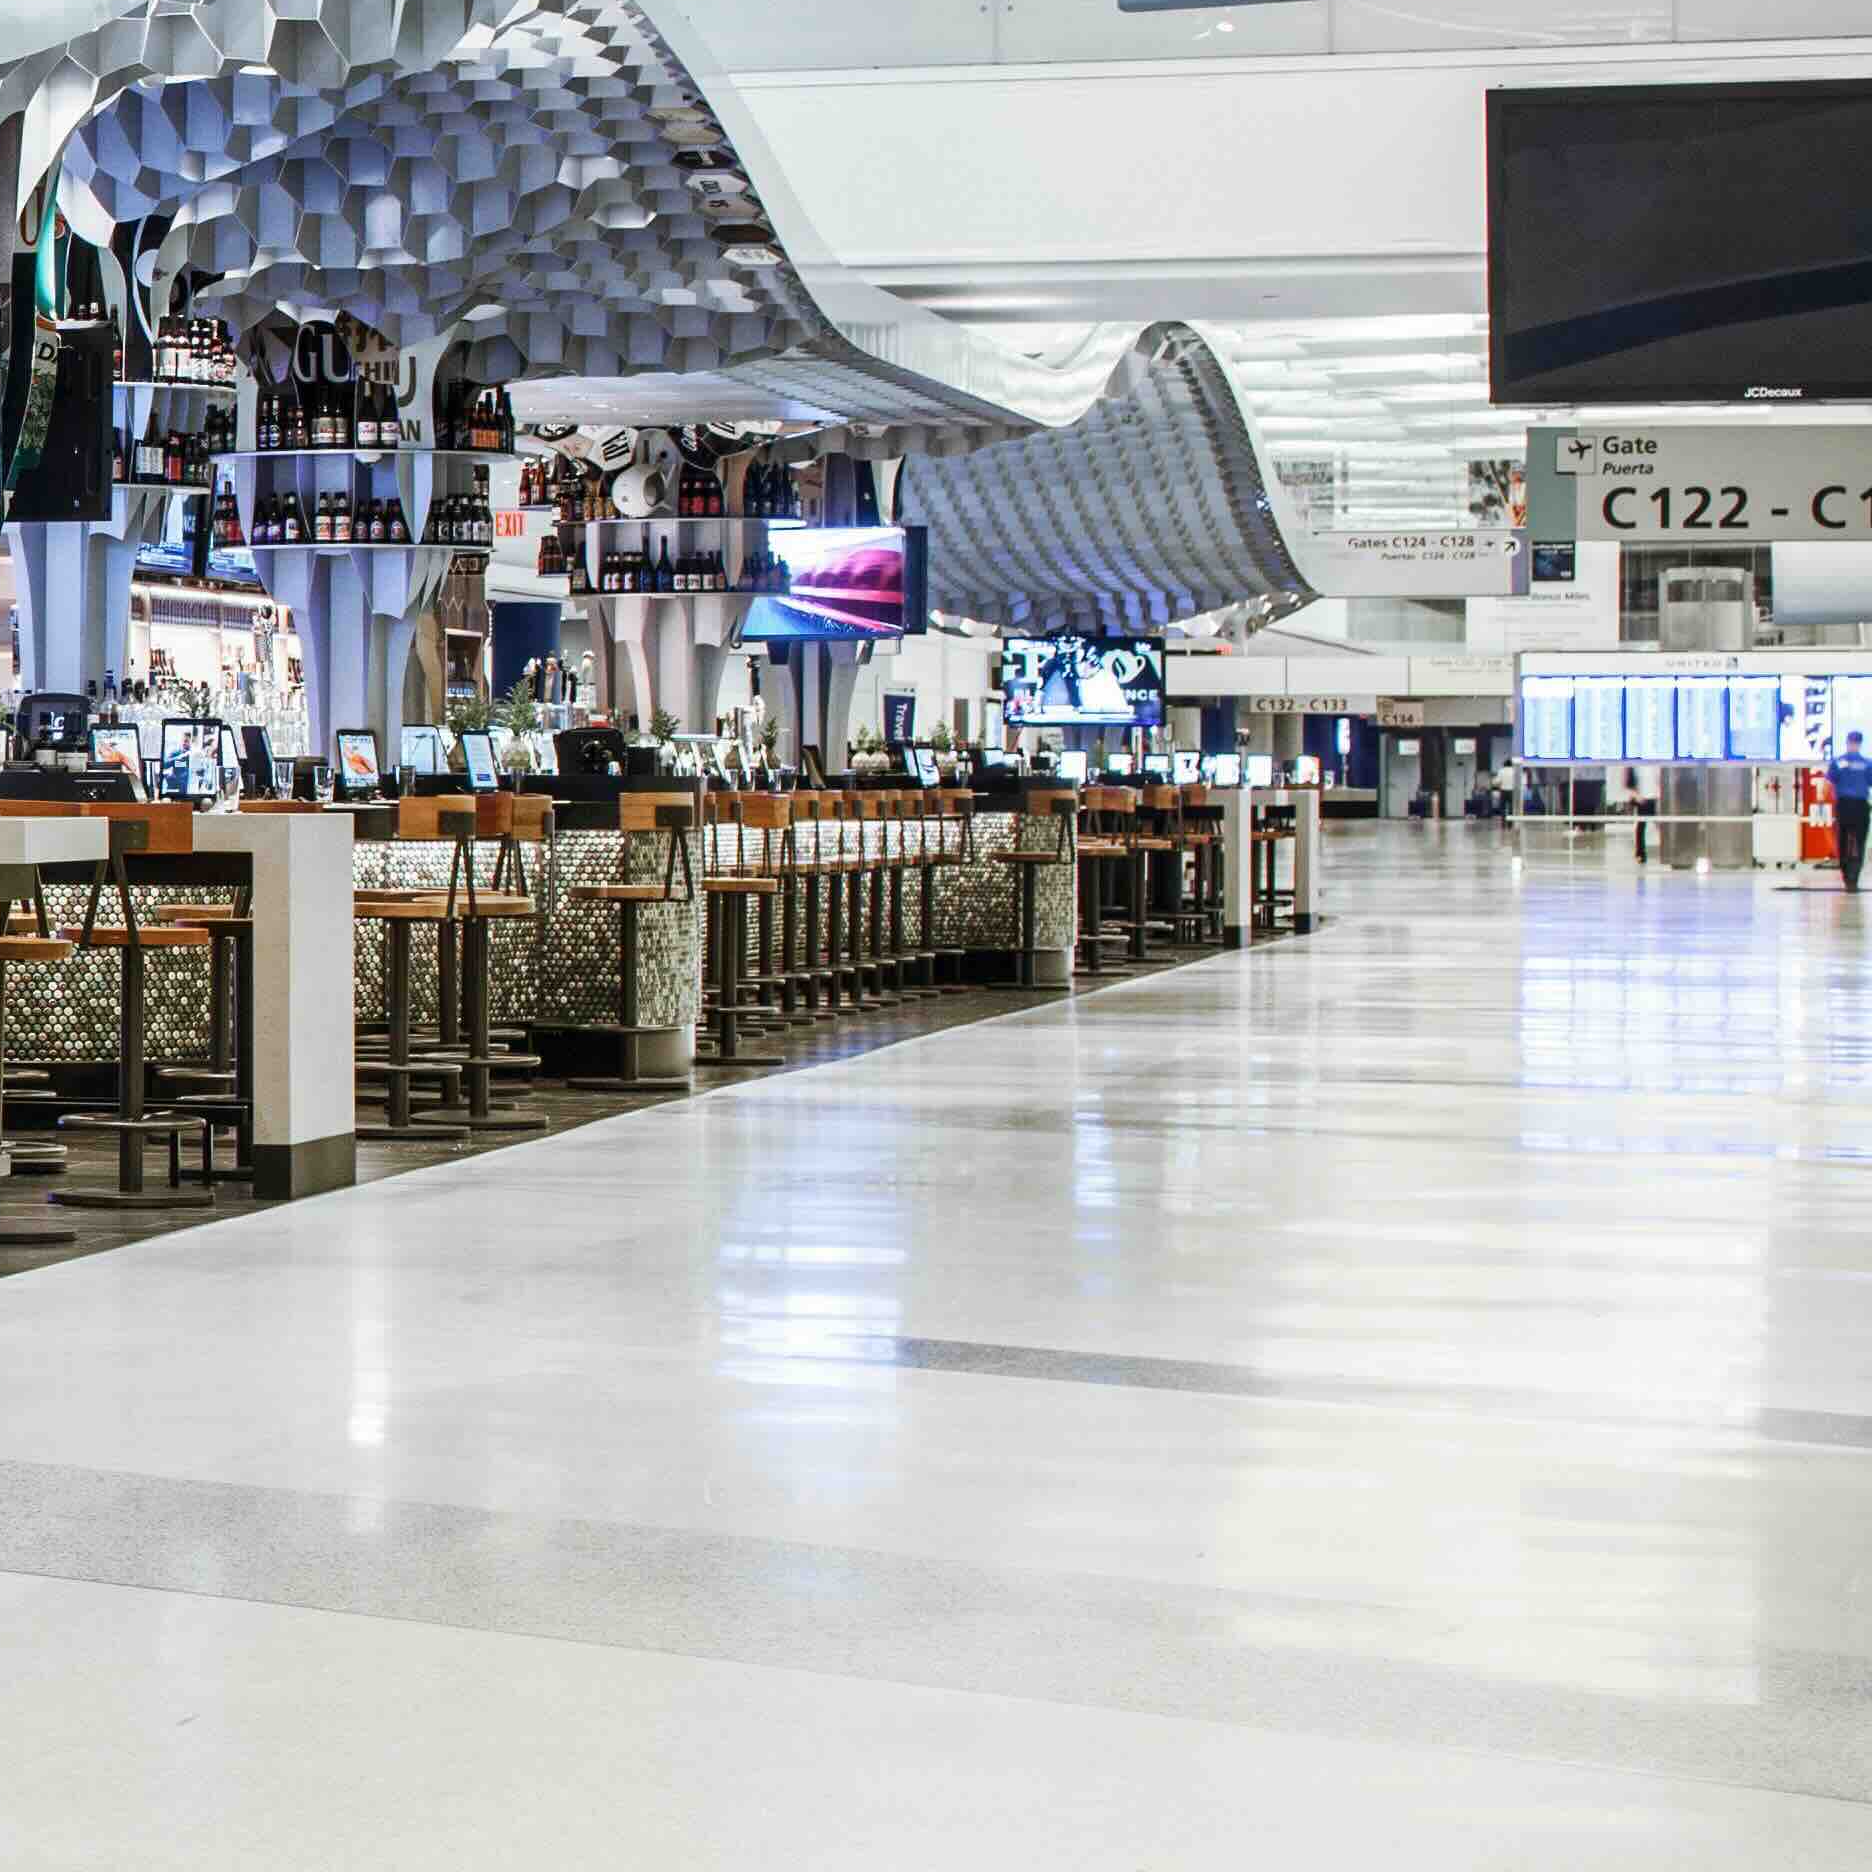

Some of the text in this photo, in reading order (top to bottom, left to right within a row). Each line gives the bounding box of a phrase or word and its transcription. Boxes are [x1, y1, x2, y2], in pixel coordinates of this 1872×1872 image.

[1743, 386, 1803, 398] JCDecaux
[1602, 435, 1658, 455] Gate
[1601, 462, 1655, 476] Puerta
[1601, 485, 1749, 529] C122
[495, 511, 525, 537] EXIT
[1348, 537, 1388, 549] Gates
[1392, 535, 1427, 548] C124
[1439, 535, 1475, 547] C128
[1256, 698, 1293, 712] C132
[1309, 698, 1348, 711] C133
[1382, 714, 1415, 725] C134
